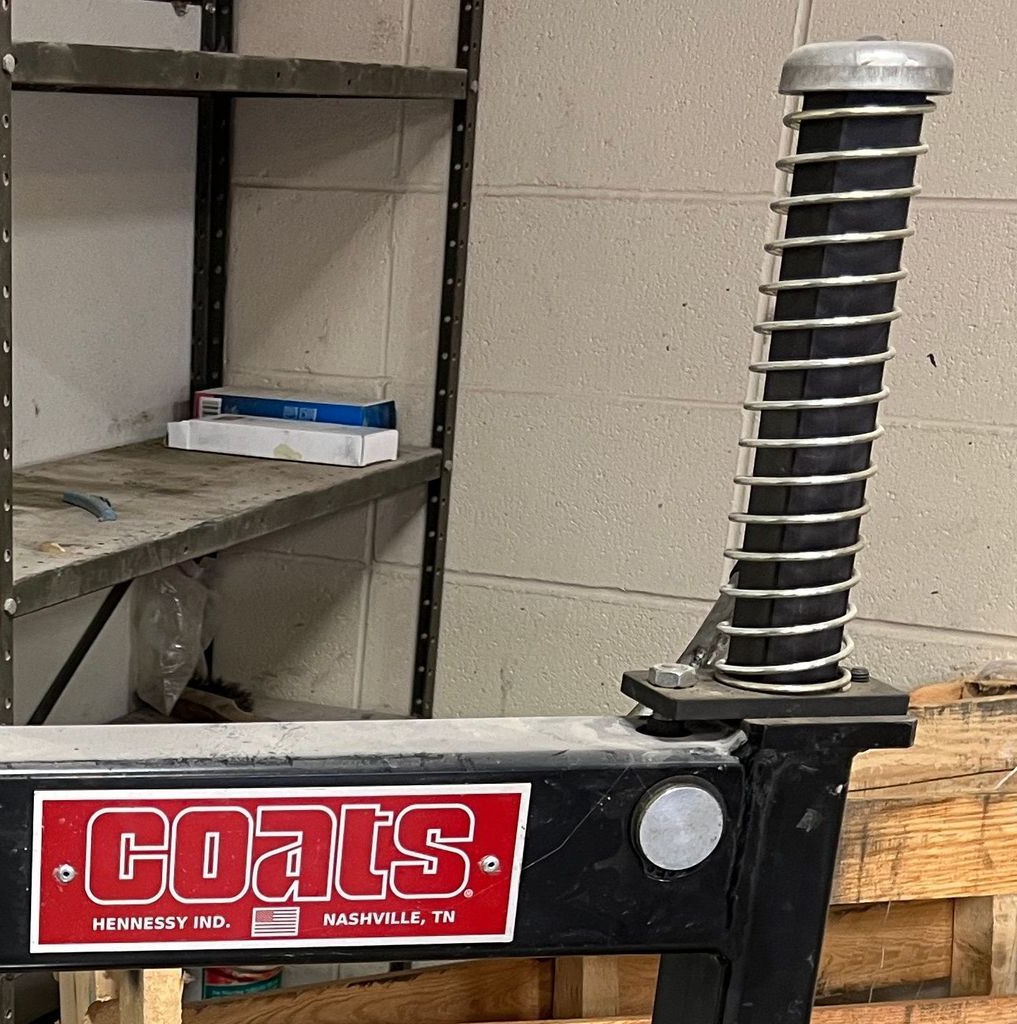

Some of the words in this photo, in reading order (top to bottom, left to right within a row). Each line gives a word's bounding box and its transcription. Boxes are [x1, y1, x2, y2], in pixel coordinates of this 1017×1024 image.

[93, 916, 185, 932] HENNESSY
[193, 915, 231, 930] IND.
[323, 912, 424, 928] NASHVILLE,
[432, 910, 455, 924] TN
